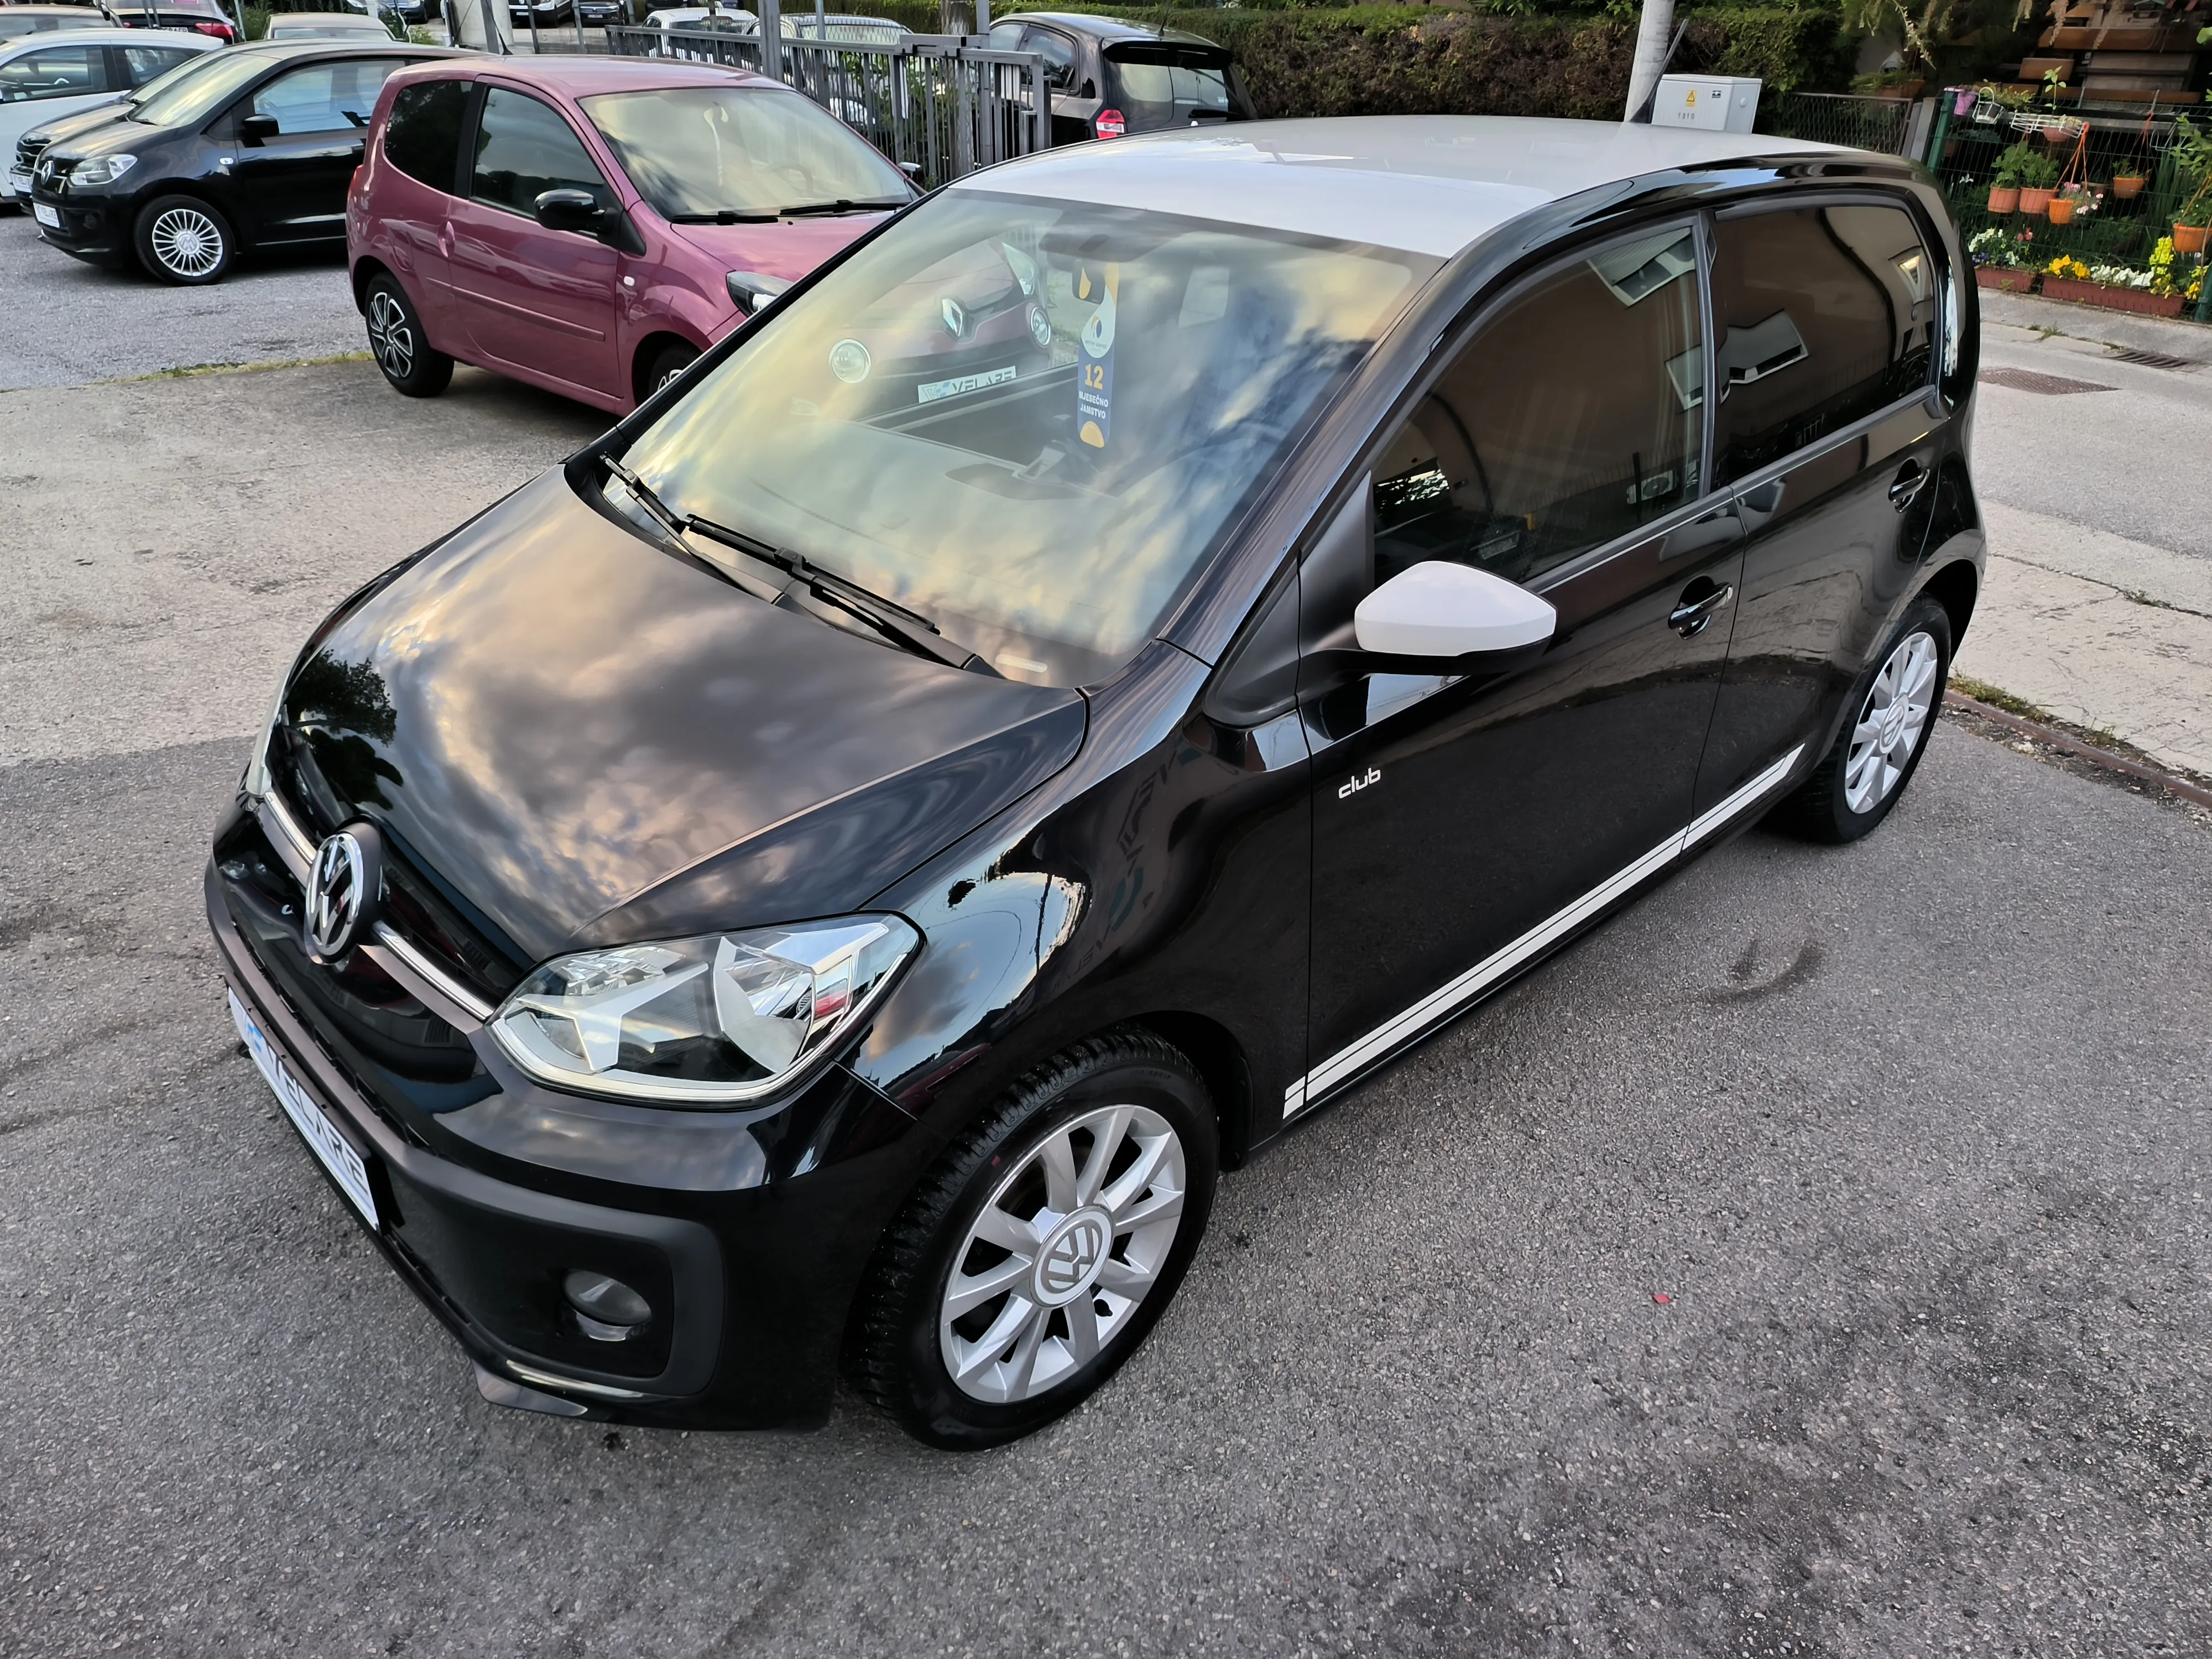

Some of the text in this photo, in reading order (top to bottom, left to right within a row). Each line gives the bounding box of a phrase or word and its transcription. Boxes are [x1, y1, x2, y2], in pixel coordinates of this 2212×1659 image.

[1084, 363, 1103, 390] 12
[1079, 390, 1109, 408] MJESEČNO
[1080, 403, 1106, 419] JAMSTVO
[1338, 767, 1381, 799] club
